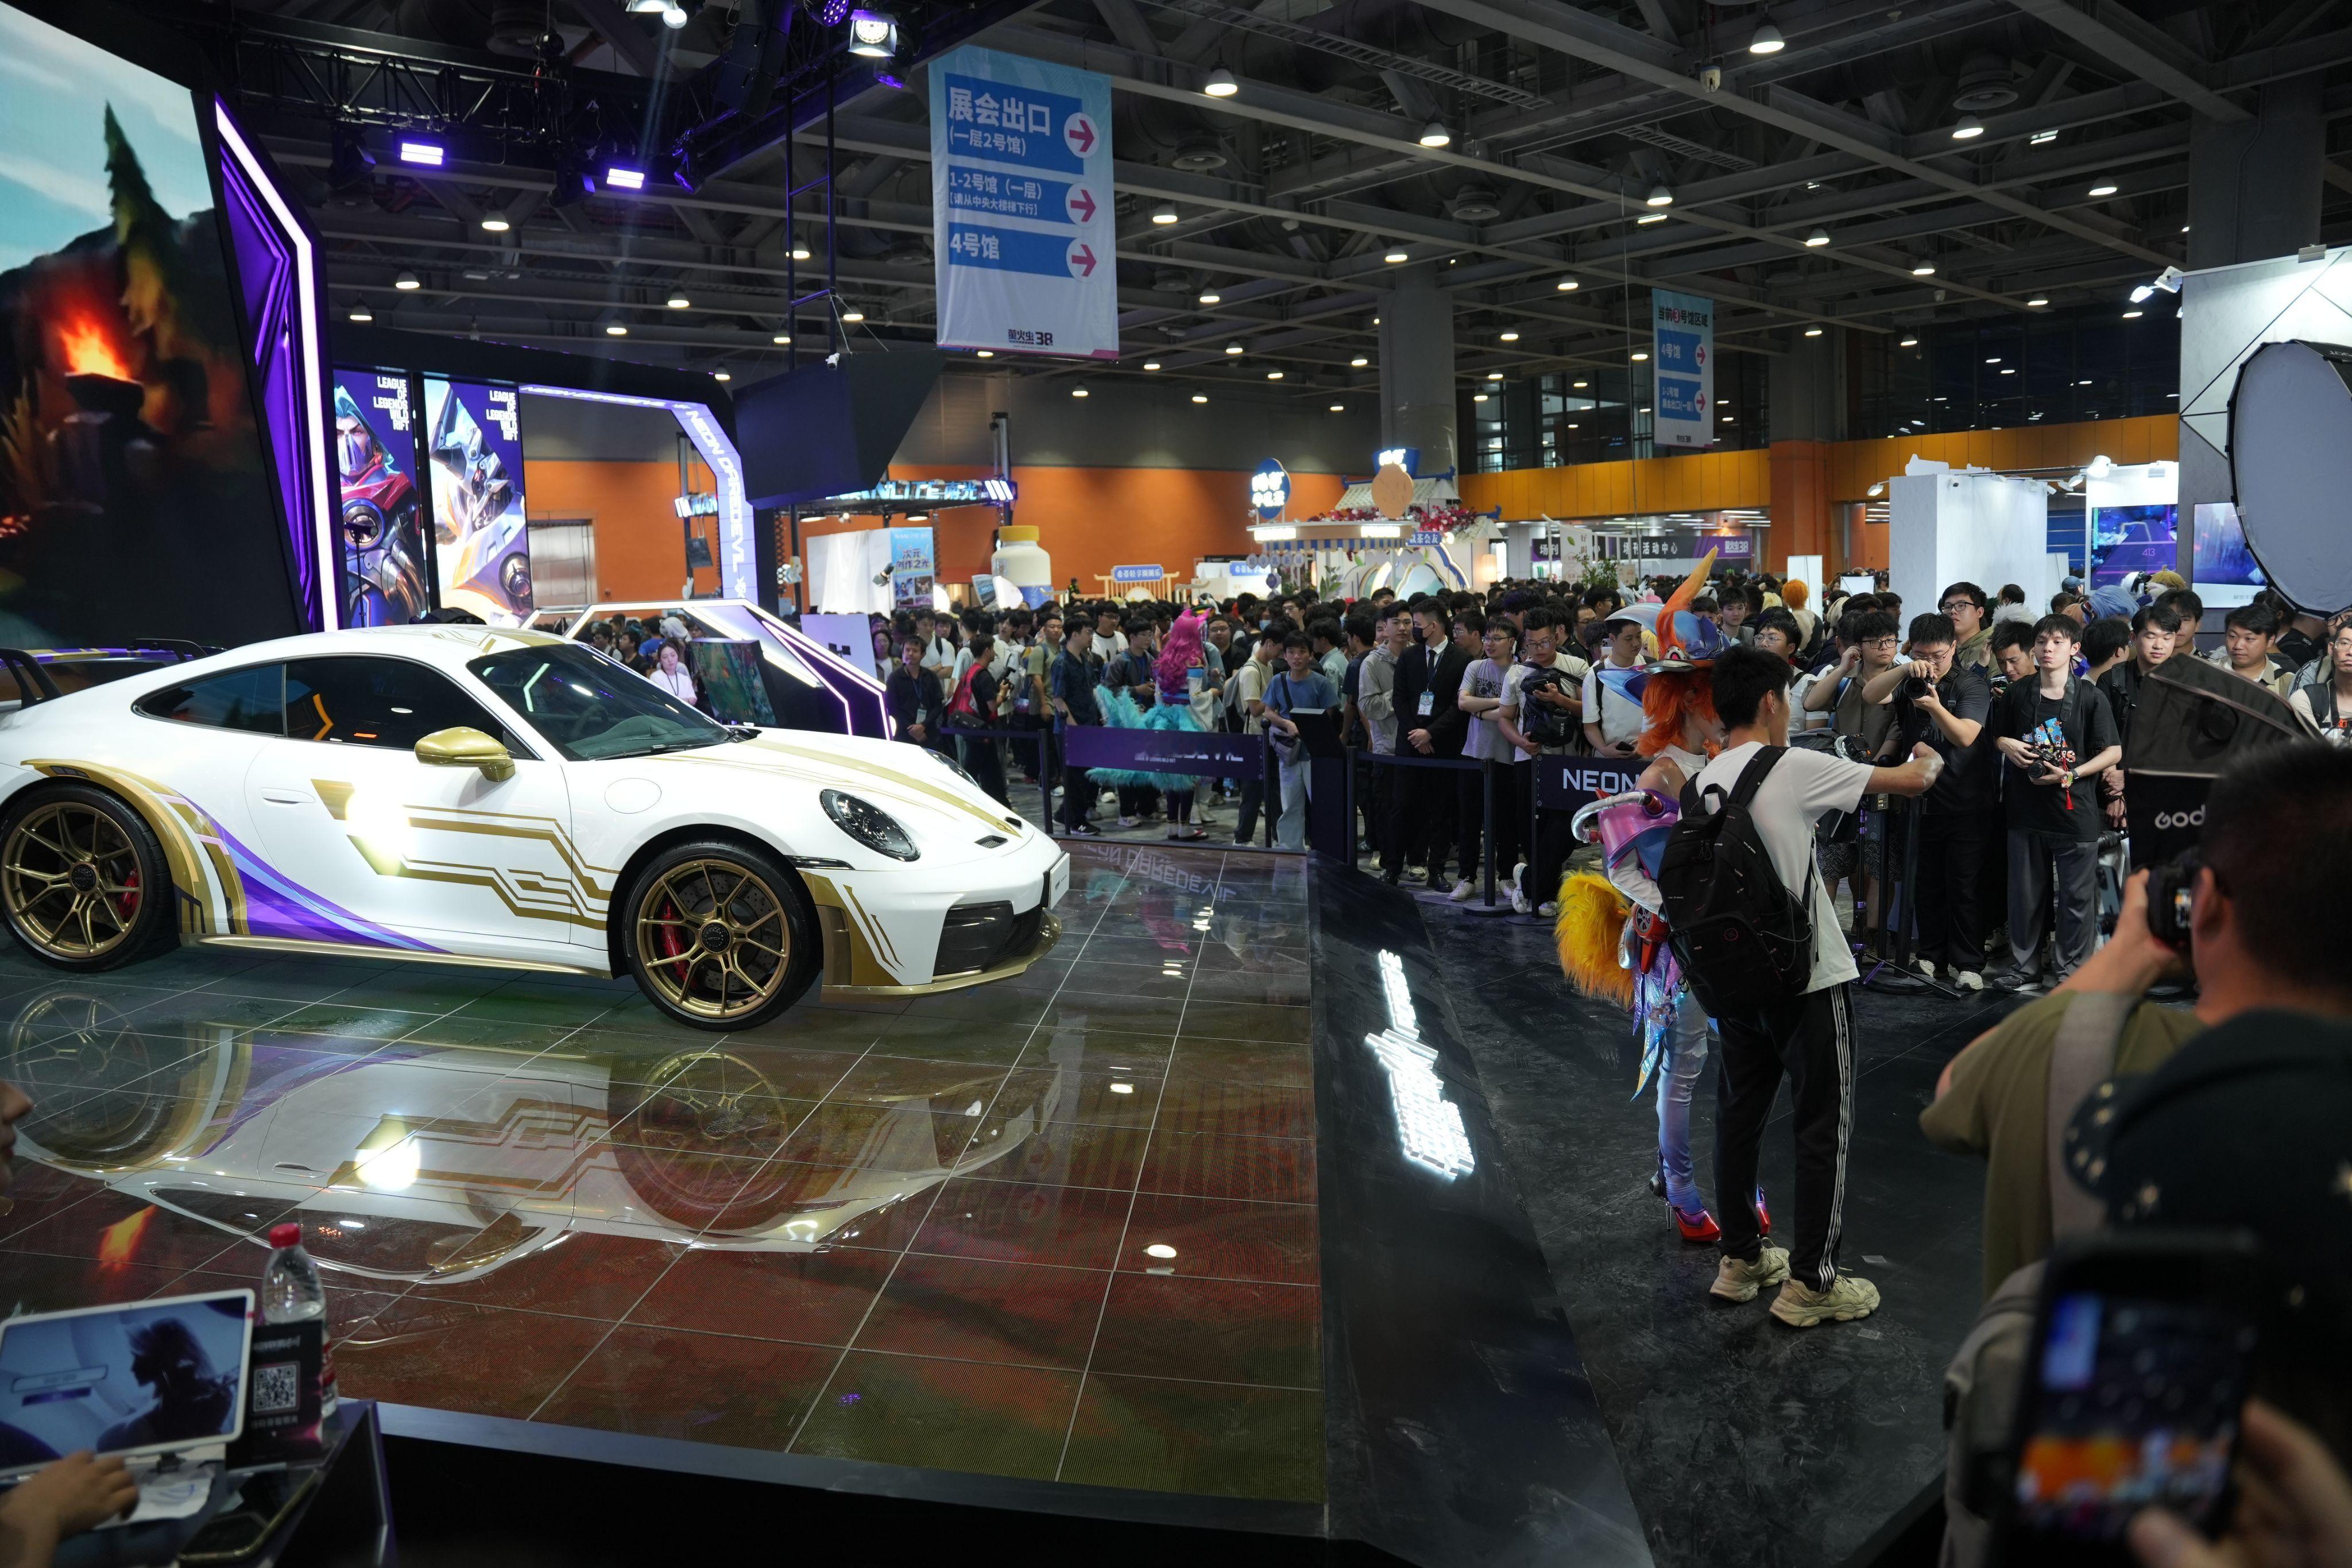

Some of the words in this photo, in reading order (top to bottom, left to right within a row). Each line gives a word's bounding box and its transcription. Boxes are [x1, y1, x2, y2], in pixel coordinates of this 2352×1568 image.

[948, 87, 1050, 137] 展会出口
[949, 126, 1026, 157] (一层2号馆)
[949, 233, 1000, 260] 4号馆
[1661, 343, 1681, 359] 4号馆
[377, 376, 406, 389] LEAGUE
[397, 389, 407, 400] OF
[489, 390, 515, 402] LEAGUE
[373, 396, 408, 411] LEGENDS
[506, 401, 516, 412] OF
[389, 408, 409, 421] WILD
[486, 409, 517, 421] LEGENDS
[393, 419, 409, 431] RIFT
[500, 420, 517, 431] WILD
[503, 429, 518, 441] RIFT
[686, 411, 725, 455] NEON
[717, 457, 745, 572] DAREDEVIL
[945, 481, 977, 500] 南光
[1623, 541, 1678, 555] 场刊活动中心
[2141, 548, 2156, 556] 413
[1562, 768, 1641, 793] NEON
[666, 933, 679, 965] PRSCHE
